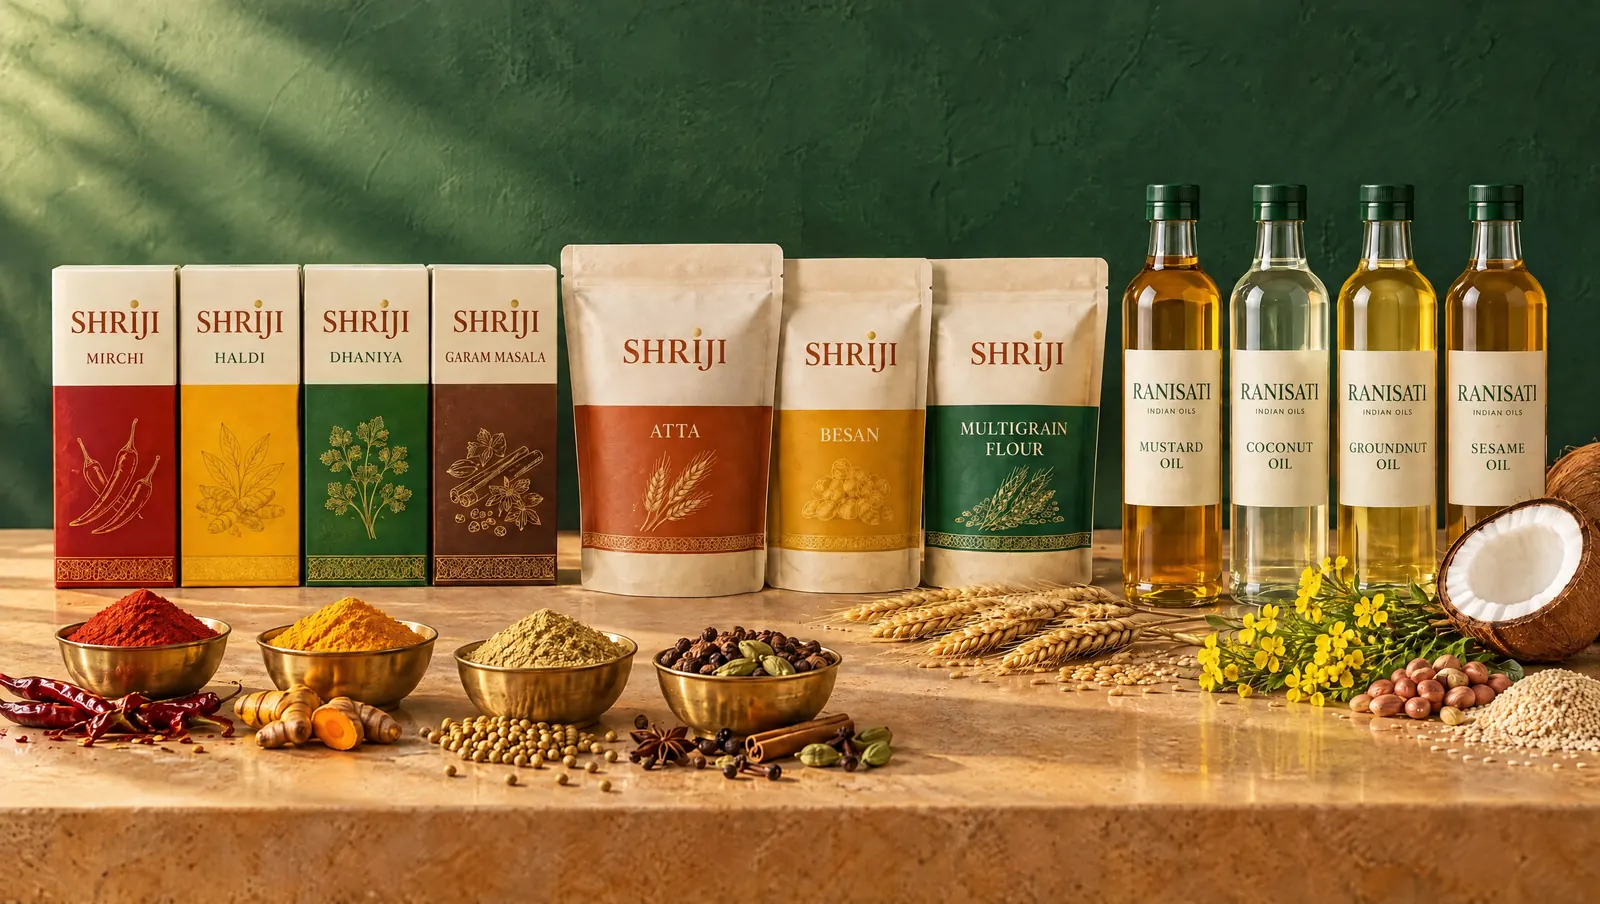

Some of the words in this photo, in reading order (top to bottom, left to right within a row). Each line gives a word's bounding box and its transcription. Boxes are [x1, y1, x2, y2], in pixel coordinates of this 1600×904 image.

[87, 352, 144, 365] MIRCHI
[215, 352, 265, 364] HALDI
[330, 351, 403, 363] DHANIYA
[445, 351, 491, 363] GARAM
[494, 351, 546, 363] MASALA
[1133, 382, 1211, 401] RANISATI
[1241, 383, 1319, 401] RANISATI
[1348, 383, 1427, 402] RANISATI
[1458, 384, 1537, 403] RANISATI
[1147, 407, 1176, 415] INDIAN
[1178, 407, 1196, 415] OILS
[1287, 407, 1305, 415] OILS
[1361, 408, 1392, 416] INDIAN
[1394, 408, 1413, 416] OILS
[1472, 409, 1503, 417] INDIAN
[649, 423, 700, 439] ATTA
[960, 421, 1068, 436] MULTIGRAIN
[820, 427, 880, 443] BESAN
[985, 441, 1044, 456] FLOUR
[1140, 441, 1204, 453] MUSTARD
[1246, 441, 1314, 454] COCONUT
[1348, 441, 1428, 454] GROUNDNUT
[1471, 442, 1526, 455] SESAME
[1159, 457, 1184, 469] OIL
[1268, 458, 1293, 470] OIL
[1376, 458, 1401, 470] OIL
[1486, 459, 1511, 471] OIL
